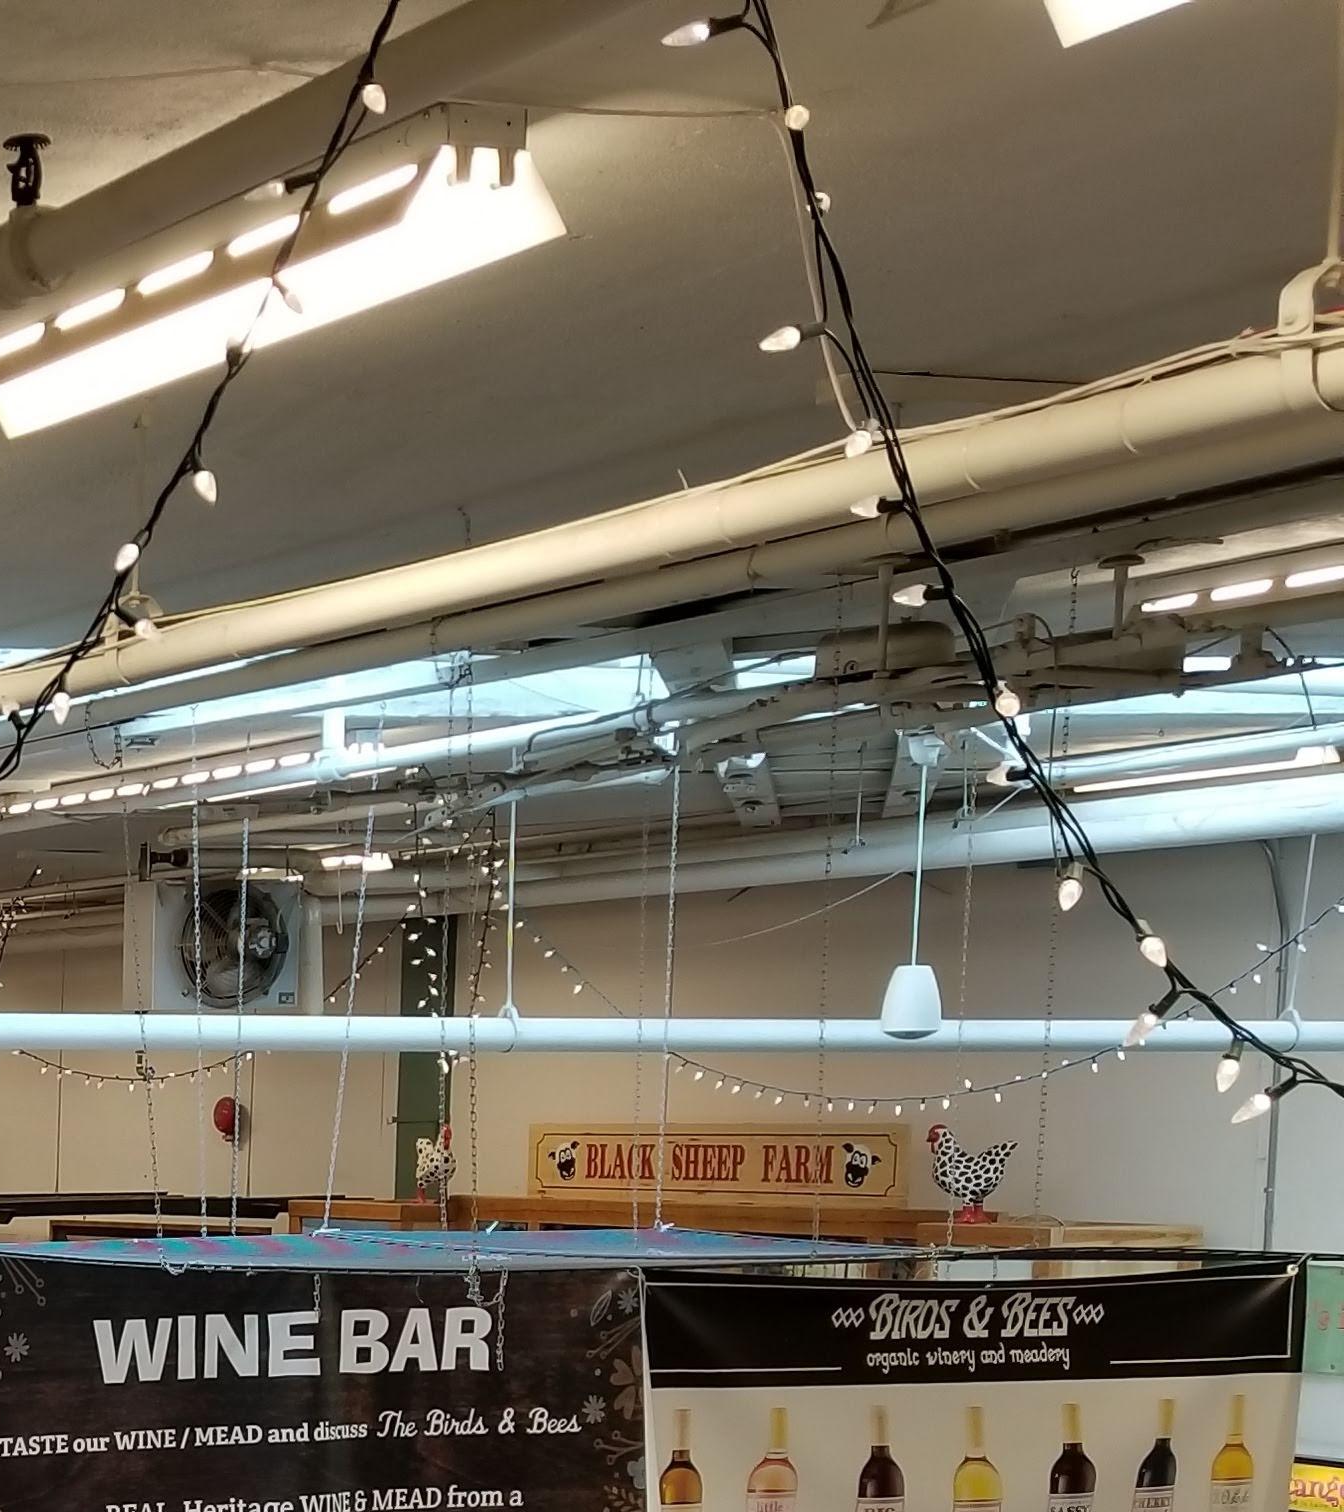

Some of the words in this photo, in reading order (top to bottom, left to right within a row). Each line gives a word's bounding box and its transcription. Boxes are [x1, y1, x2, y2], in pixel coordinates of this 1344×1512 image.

[585, 1143, 656, 1179] BLACK
[671, 1144, 746, 1182] SHEEP
[761, 1145, 834, 1183] FARM
[962, 1294, 995, 1339] &
[92, 1309, 321, 1384] WINE
[338, 1306, 491, 1374] BAR
[866, 1347, 920, 1375] organic
[925, 1346, 976, 1373] winery
[980, 1342, 1005, 1365] and
[1009, 1341, 1070, 1370] meadery
[0, 1433, 69, 1457] TASTE
[72, 1433, 109, 1454] our
[113, 1428, 176, 1452] WINE
[179, 1426, 193, 1451] /
[193, 1424, 263, 1447] MEAD
[267, 1421, 310, 1444] and
[313, 1418, 368, 1441] discuss
[376, 1409, 418, 1439] The
[424, 1408, 489, 1437] Birds
[497, 1408, 517, 1435] &
[527, 1406, 583, 1435] Bees
[354, 1491, 369, 1512] &
[372, 1487, 442, 1512] MEAD
[446, 1483, 504, 1509] from
[508, 1489, 524, 1508] a
